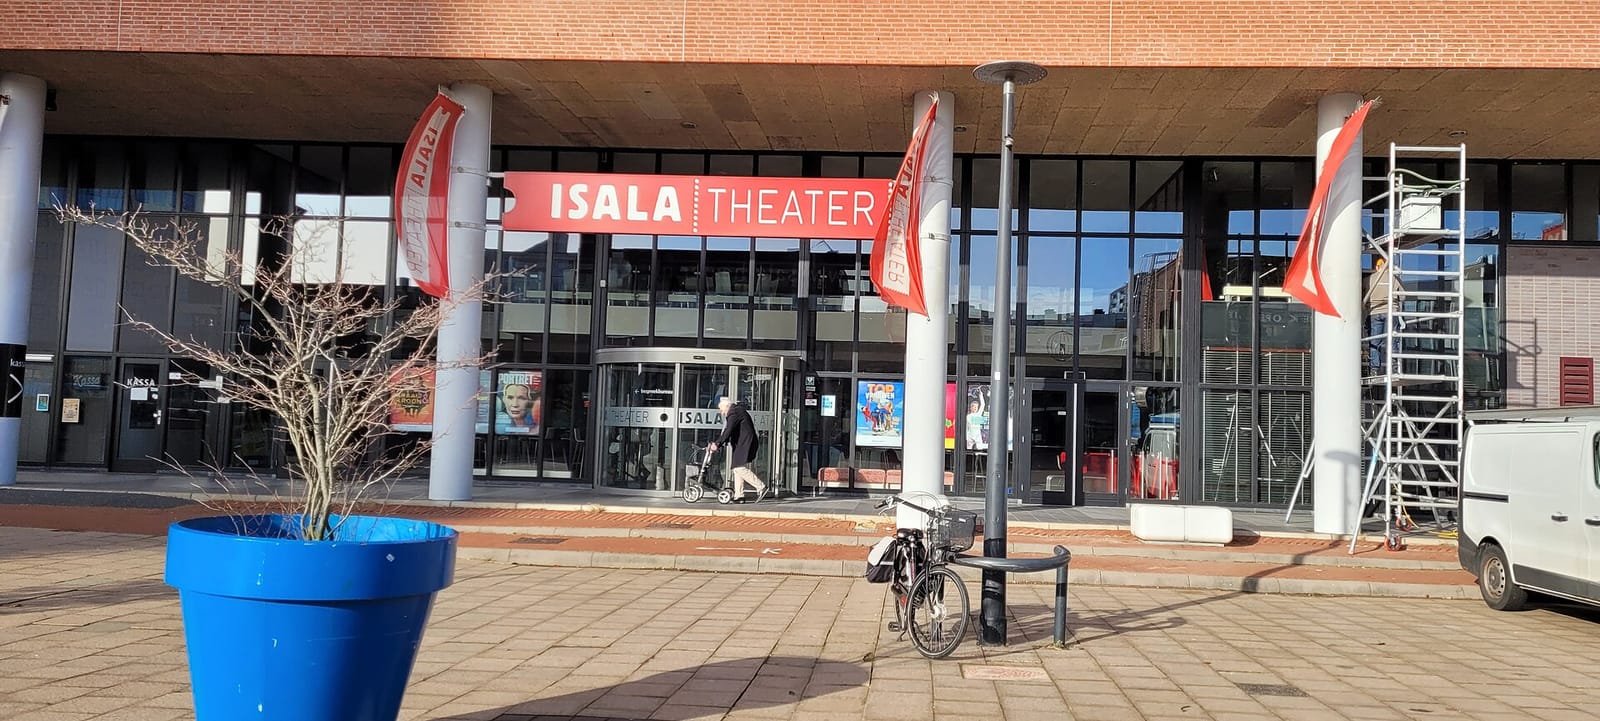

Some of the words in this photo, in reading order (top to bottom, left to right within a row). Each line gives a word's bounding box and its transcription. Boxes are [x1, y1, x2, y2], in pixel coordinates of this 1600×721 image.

[550, 183, 682, 222] ISALA
[707, 187, 875, 227] THEATER
[73, 374, 101, 388] Kassa
[126, 377, 156, 387] KASSA
[498, 373, 534, 384] PORTRET
[866, 383, 895, 394] TOP
[679, 411, 723, 425] ISALA
